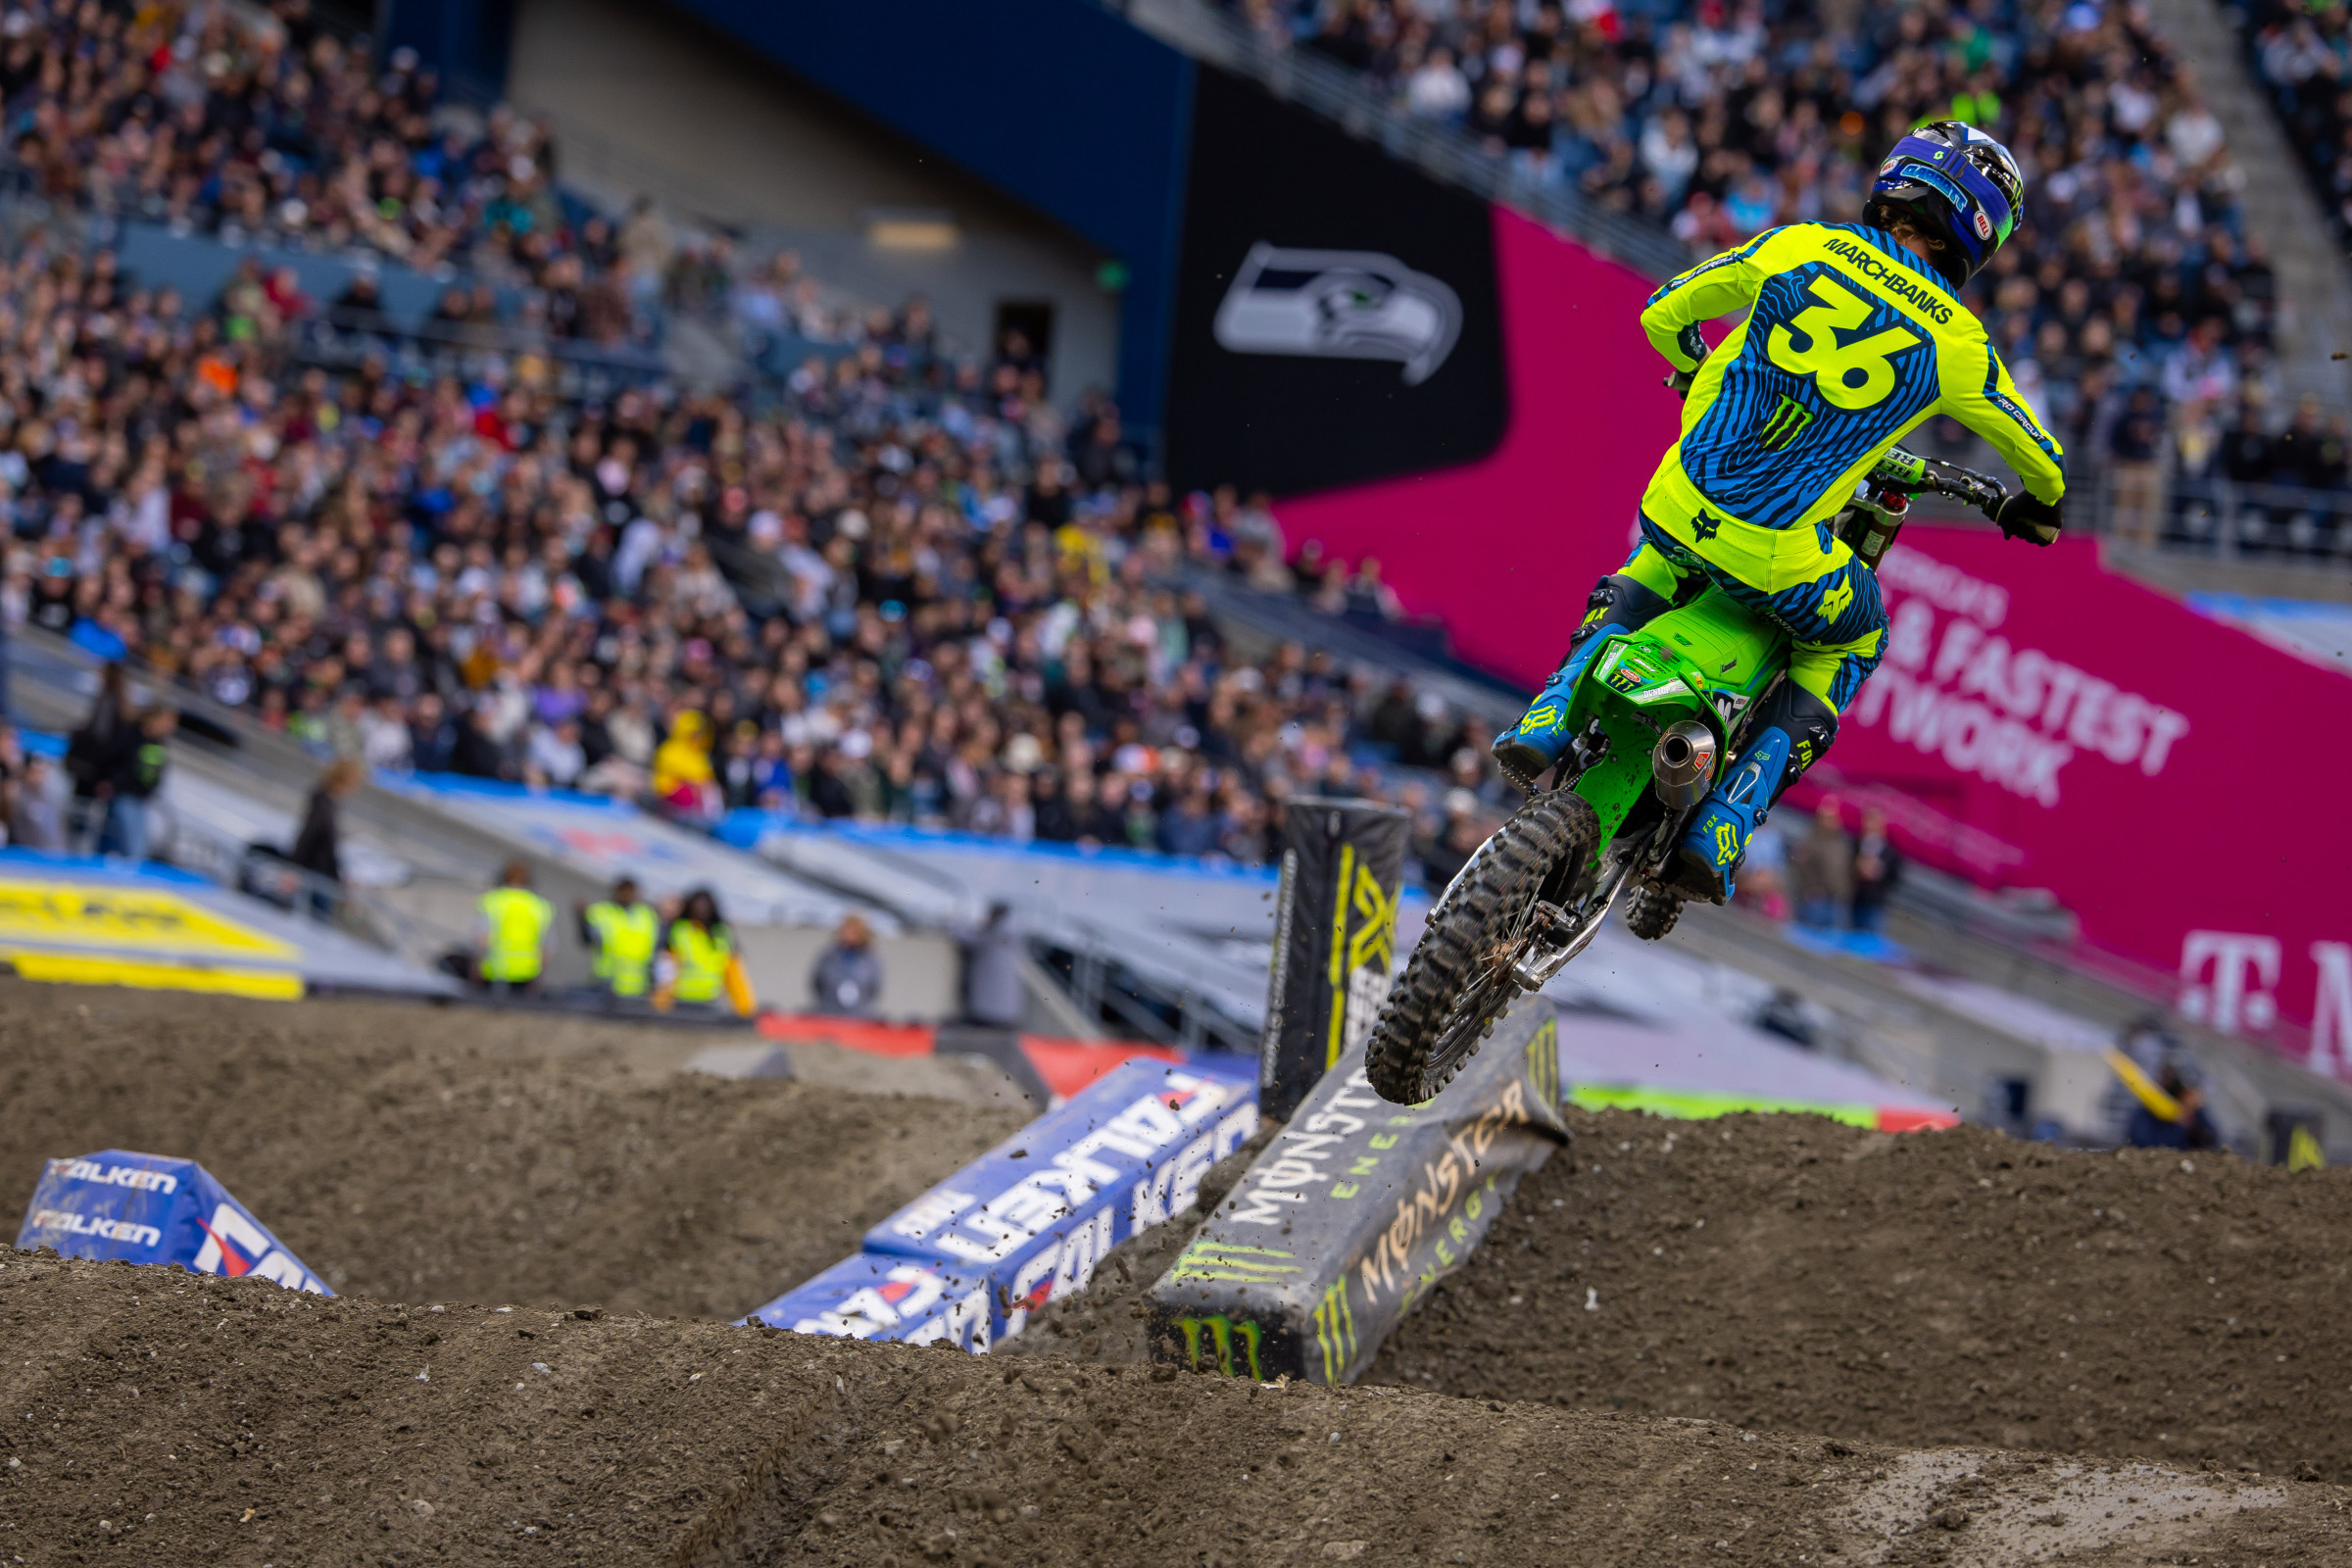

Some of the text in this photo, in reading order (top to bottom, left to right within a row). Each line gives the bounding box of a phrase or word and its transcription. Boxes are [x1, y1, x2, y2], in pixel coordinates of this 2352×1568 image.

[1977, 215, 1989, 237] BELL
[1824, 238, 1953, 324] MARCHBANKS
[1767, 273, 1923, 410] 36
[2012, 410, 2045, 441] CIRCUIT
[1642, 686, 1671, 699] DUNLOP
[1932, 617, 2191, 777] FASTEST
[1702, 814, 1719, 833] FOX
[50, 1157, 179, 1196] FALKEN
[935, 1071, 1229, 1263] FALKEN
[1360, 1080, 1530, 1304] MONSTER
[31, 1208, 162, 1248] FALKEN
